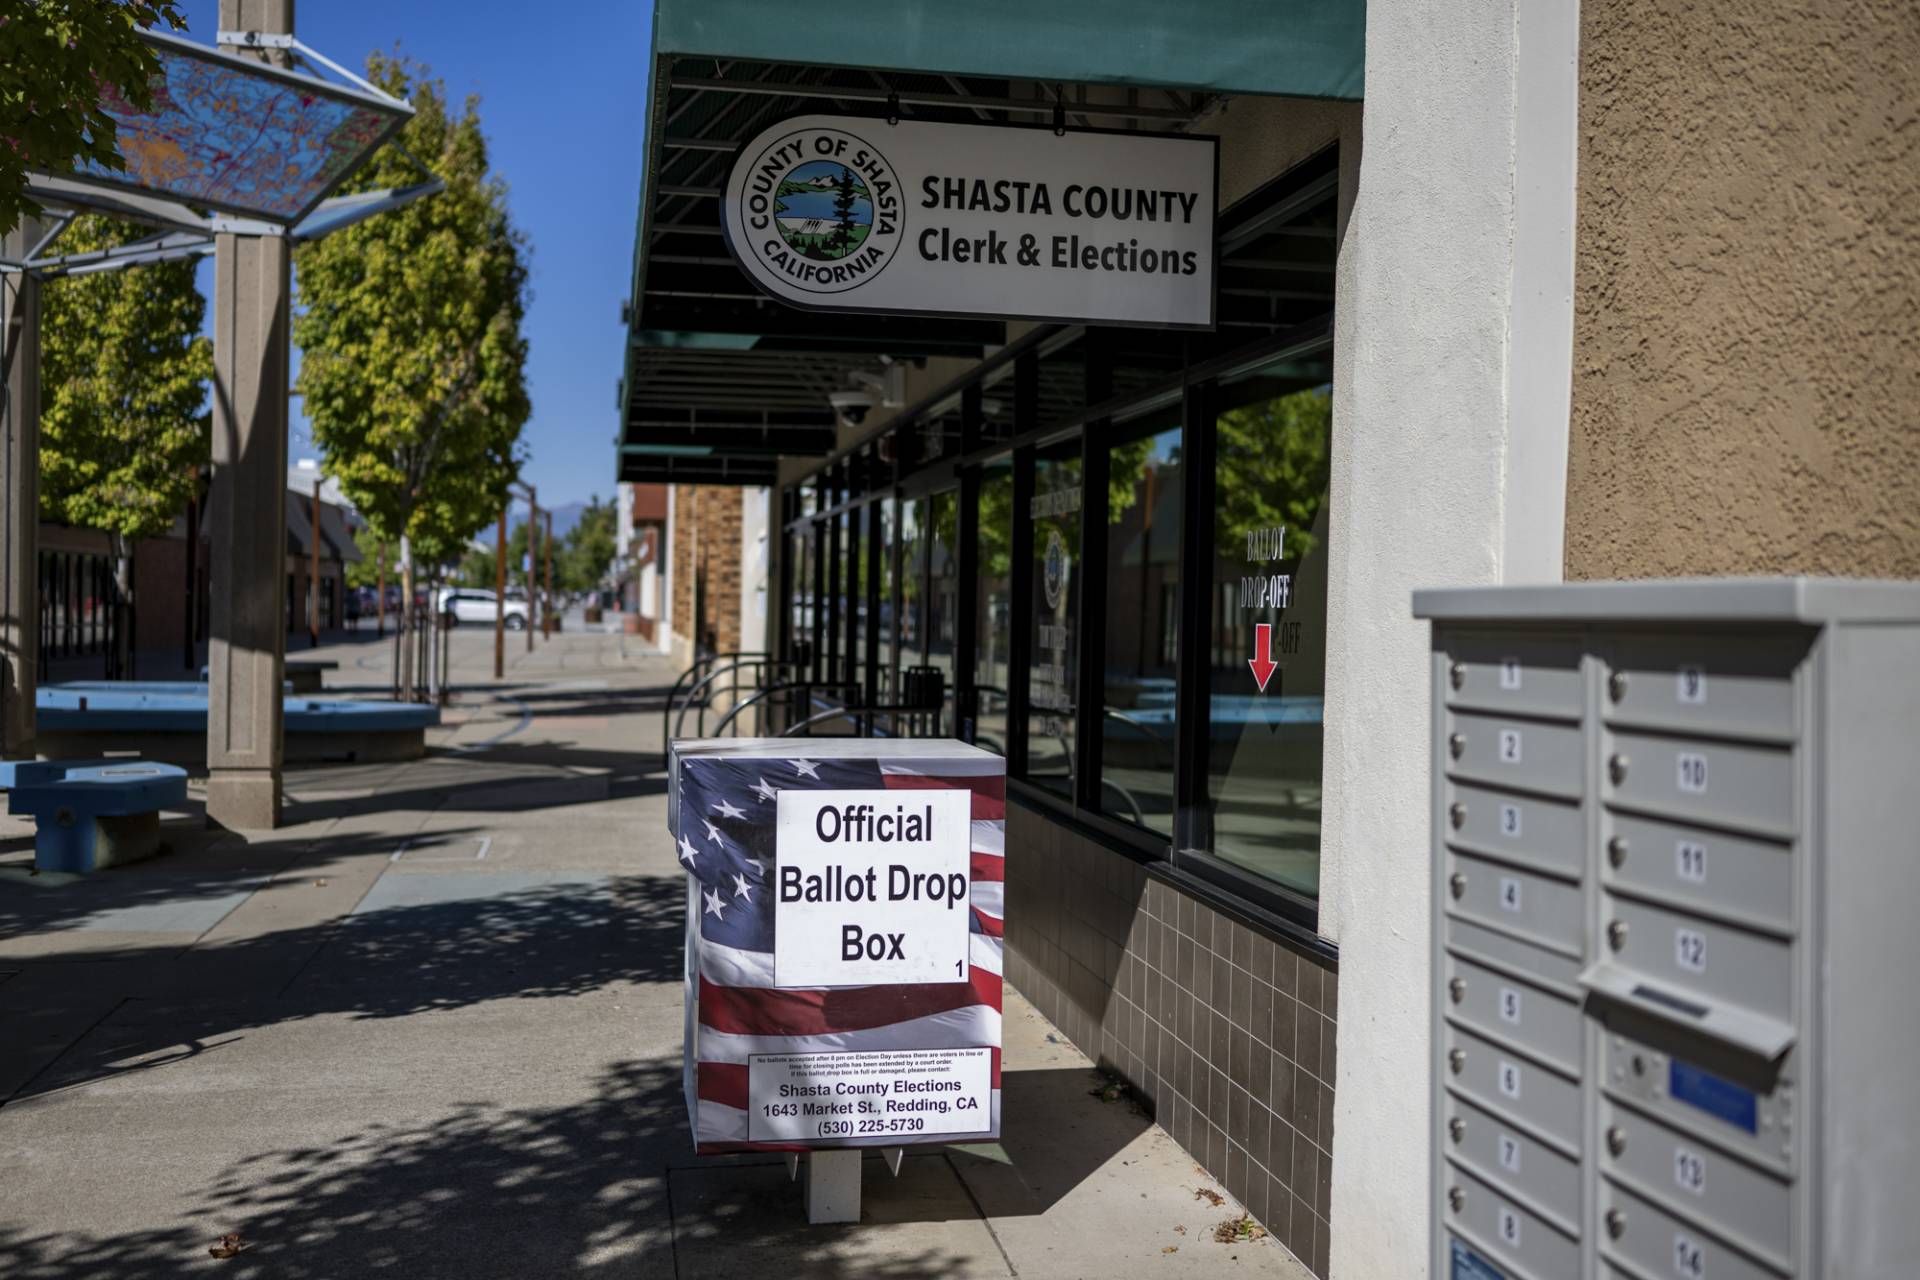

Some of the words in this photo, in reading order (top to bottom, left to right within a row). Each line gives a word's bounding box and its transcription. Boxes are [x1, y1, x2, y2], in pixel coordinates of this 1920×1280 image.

[750, 139, 804, 230] COUNTY
[814, 136, 849, 156] OF
[851, 148, 897, 237] SHASTA
[921, 176, 1053, 215] SHASTA
[1063, 184, 1198, 223] COUNTY
[763, 239, 885, 285] CALIFORNIA
[918, 228, 1007, 266] Clerk
[1016, 233, 1041, 267] &
[1051, 235, 1198, 276] Elections
[1247, 525, 1285, 562] BALLOT
[1241, 574, 1290, 608] DROP-OFF
[1506, 664, 1516, 684] 1
[1505, 736, 1516, 758] 2
[1682, 759, 1705, 787] 10
[815, 805, 932, 842] Official
[1505, 810, 1517, 832] 3
[1682, 847, 1704, 876] 11
[780, 865, 876, 903] Ballot
[888, 864, 966, 910] Drop
[1504, 882, 1516, 904] 4
[841, 924, 906, 961] Box
[1681, 937, 1704, 966] 12
[955, 960, 964, 978] 1
[1505, 995, 1516, 1018] 5
[780, 1083, 831, 1097] Shasta
[835, 1082, 890, 1097] County
[894, 1079, 962, 1093] Elections
[1504, 1069, 1516, 1091] 6
[763, 1104, 798, 1117] 1643
[802, 1101, 853, 1116] Market
[857, 1100, 881, 1115] St.,
[886, 1099, 951, 1114] Redding,
[956, 1097, 978, 1110] CA
[818, 1121, 854, 1137] (530)
[858, 1118, 924, 1133] 225-5730
[1504, 1143, 1515, 1165] 7
[1678, 1155, 1703, 1187] 13
[1504, 1216, 1515, 1238] 8
[1678, 1242, 1701, 1275] 14
